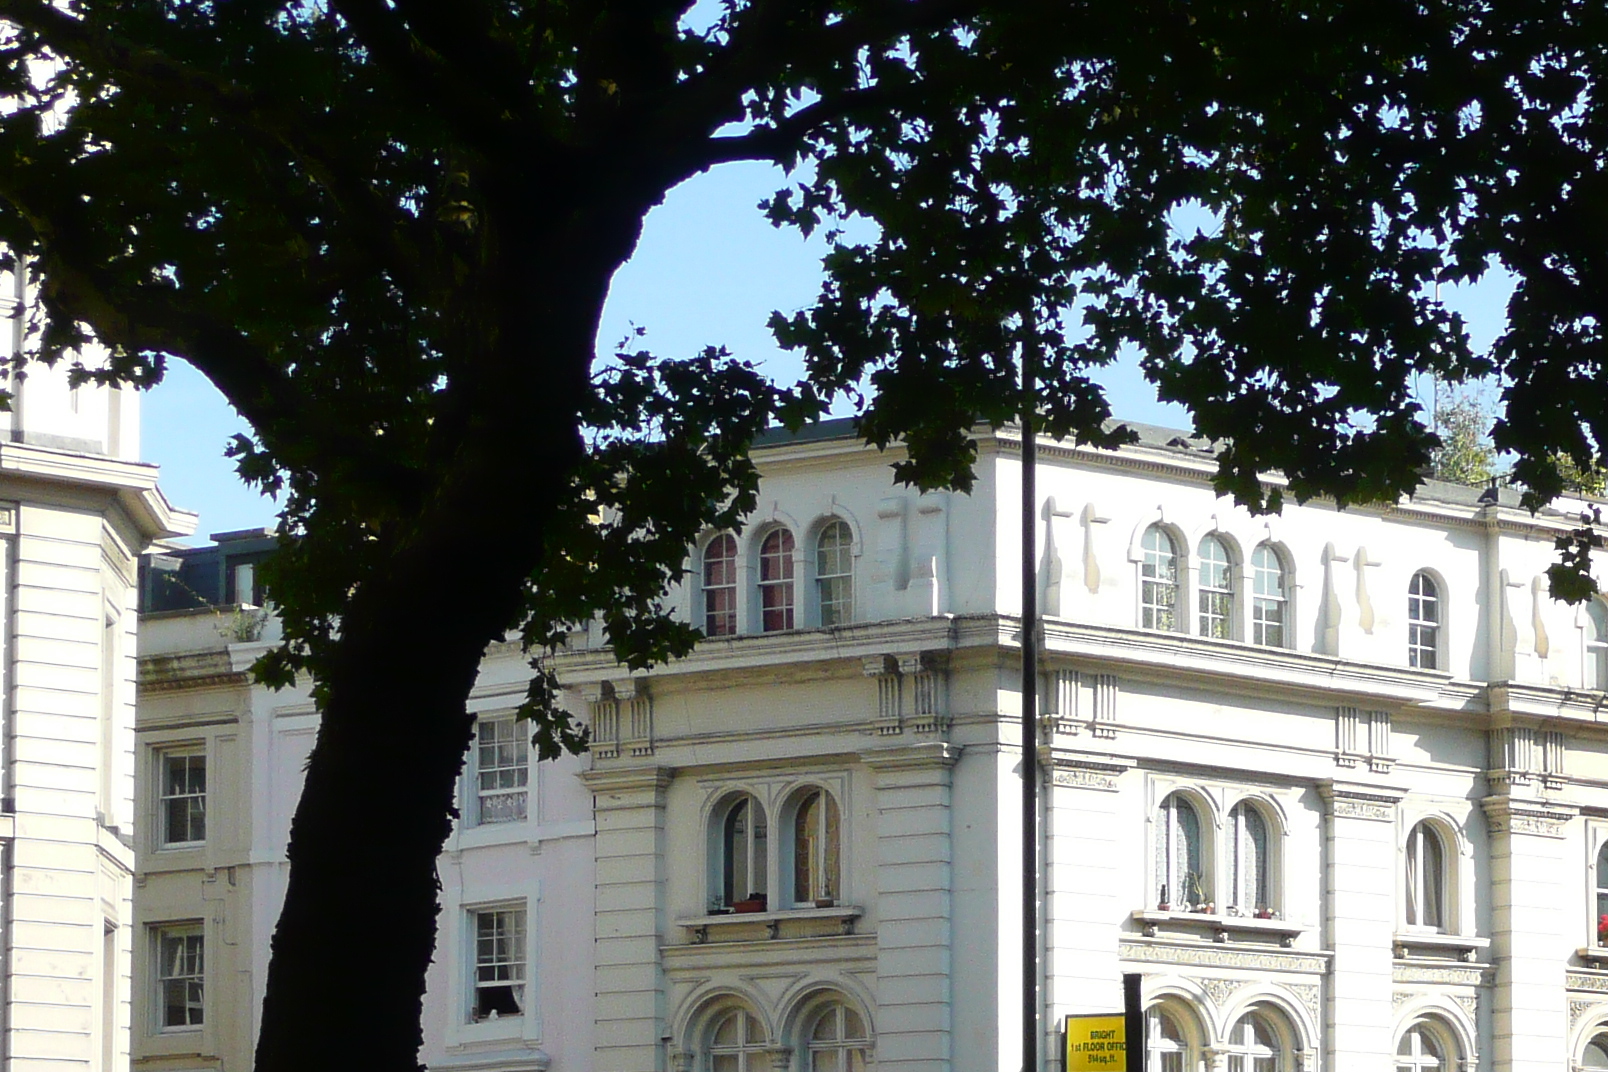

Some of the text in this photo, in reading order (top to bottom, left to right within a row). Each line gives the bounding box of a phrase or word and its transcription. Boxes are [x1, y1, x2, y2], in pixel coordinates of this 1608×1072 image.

[1089, 1030, 1115, 1040] BRIGHT
[1083, 1042, 1104, 1051] FLOOR
[1107, 1041, 1126, 1051] OFFIC
